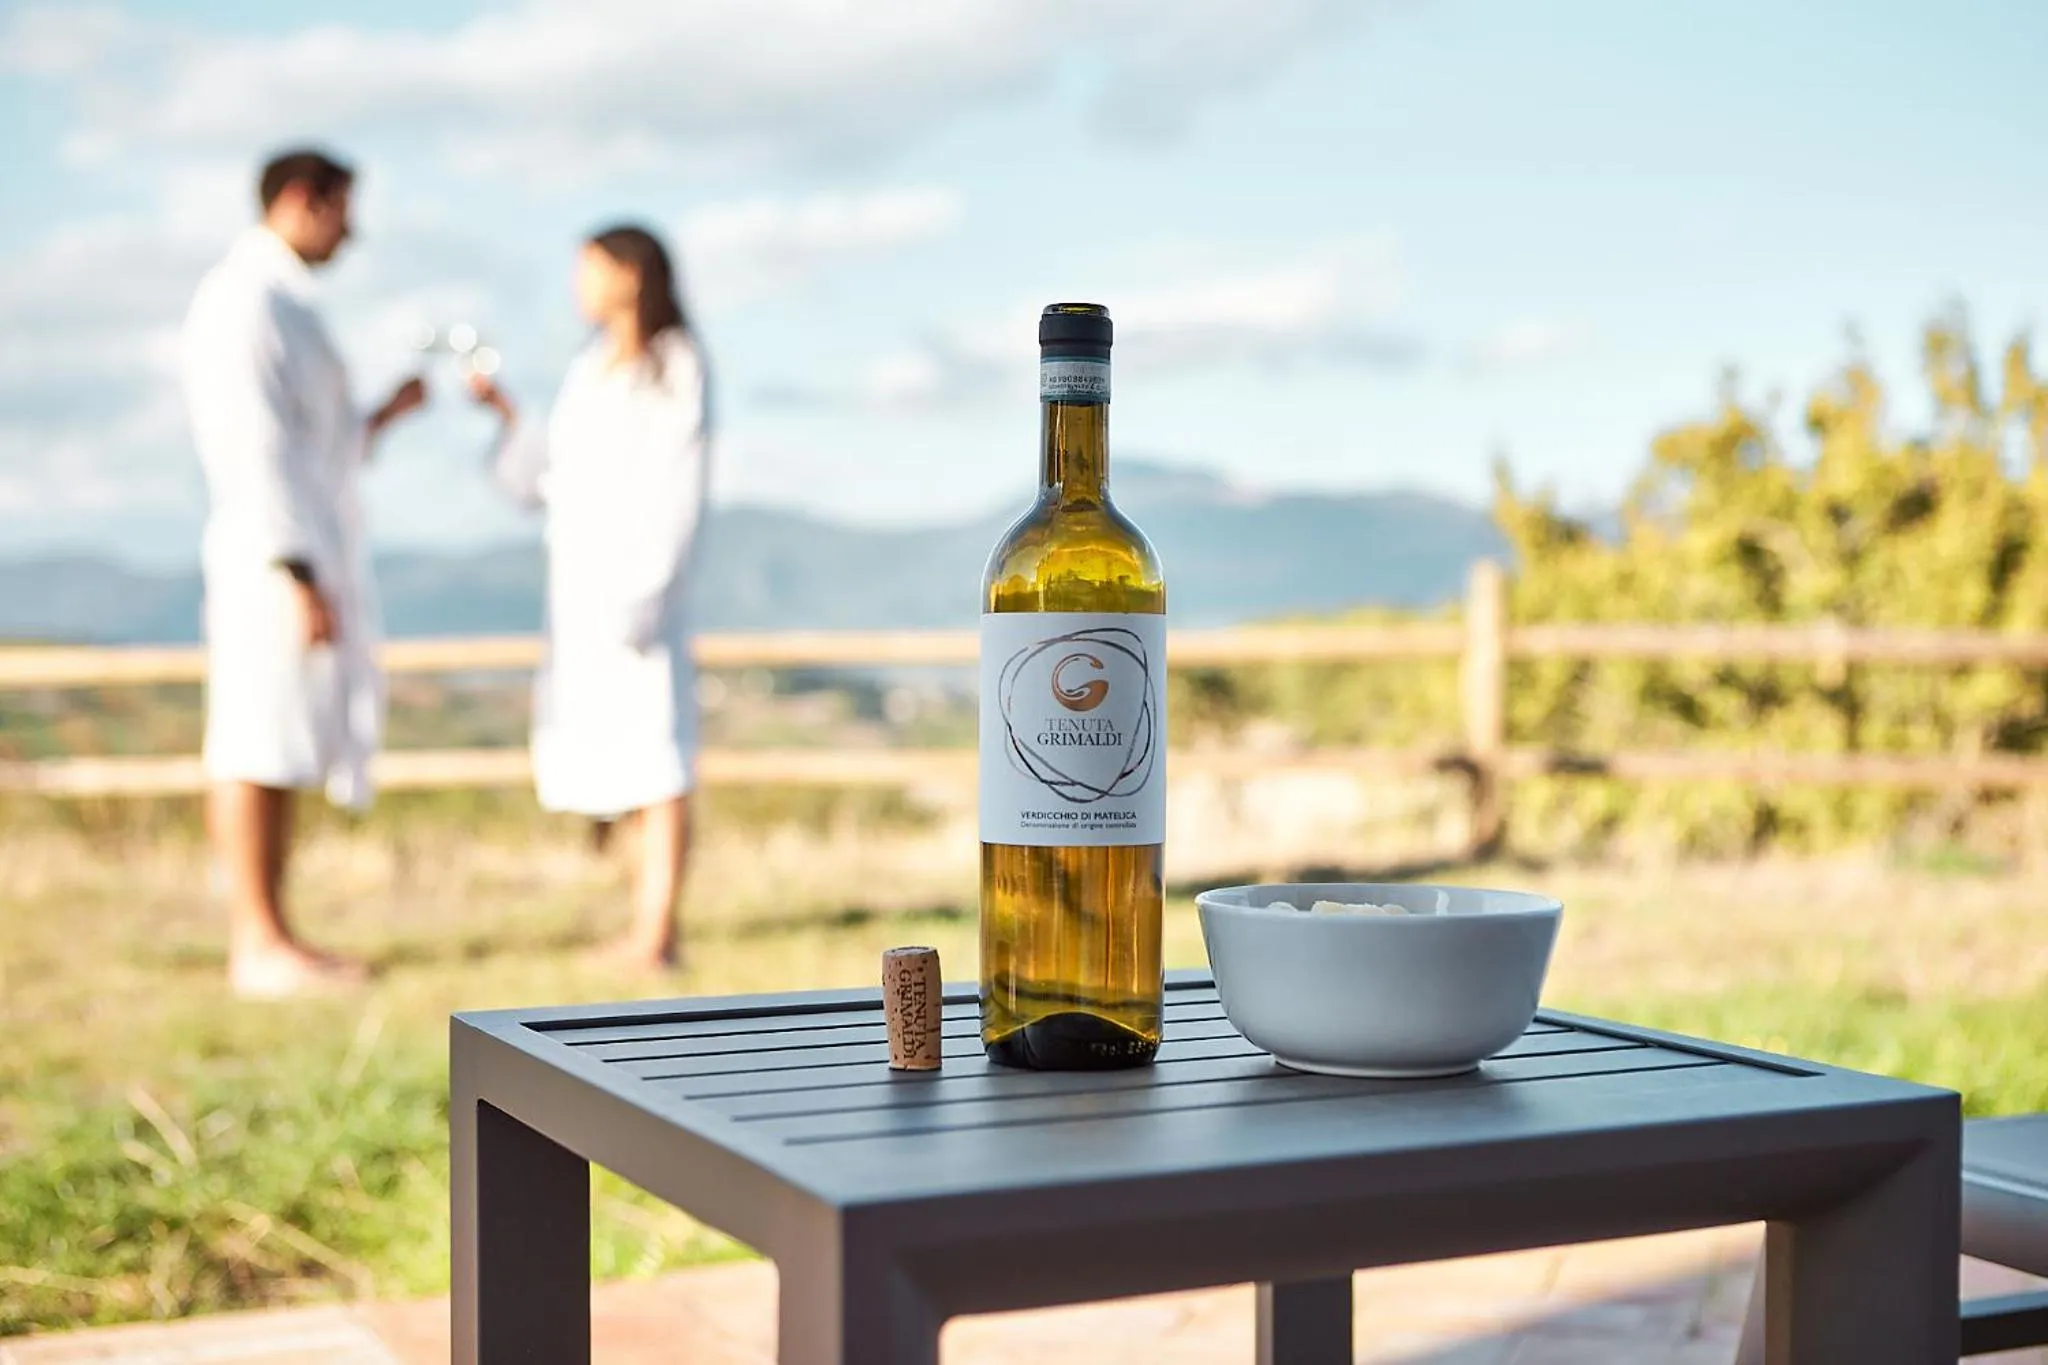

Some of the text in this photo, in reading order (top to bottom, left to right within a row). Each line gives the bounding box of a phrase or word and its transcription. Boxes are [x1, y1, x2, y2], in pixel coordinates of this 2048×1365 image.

[1045, 718, 1115, 732] TENUTA
[1037, 732, 1123, 746] GRIMALDI
[1021, 811, 1137, 820] VERDICCHIO DI MATELICA
[899, 969, 917, 1060] GRIMALDI
[913, 976, 927, 1050] TENUTA
